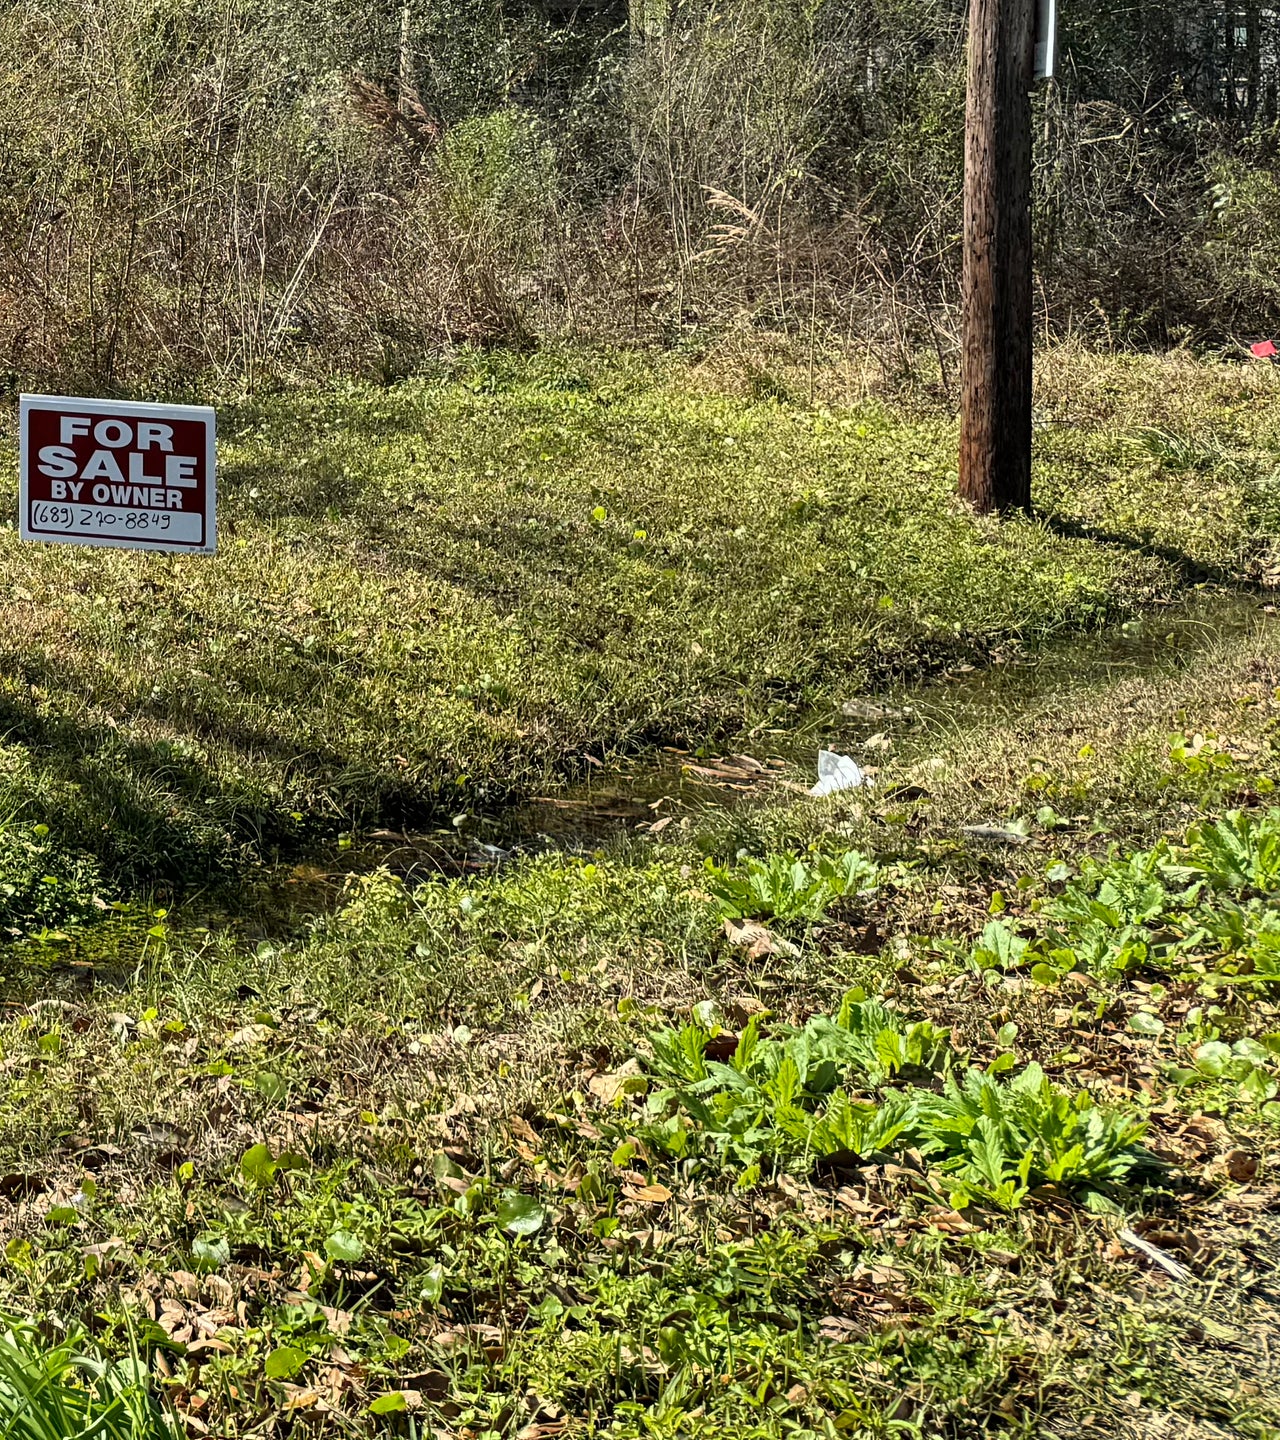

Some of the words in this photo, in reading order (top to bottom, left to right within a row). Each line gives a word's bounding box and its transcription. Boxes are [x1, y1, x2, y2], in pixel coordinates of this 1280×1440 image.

[60, 416, 174, 452] FOR
[37, 445, 197, 488] SALE
[51, 480, 84, 500] BY
[92, 484, 183, 509] OWNER
[33, 503, 74, 528] (689)
[80, 509, 171, 530] 270-8849
